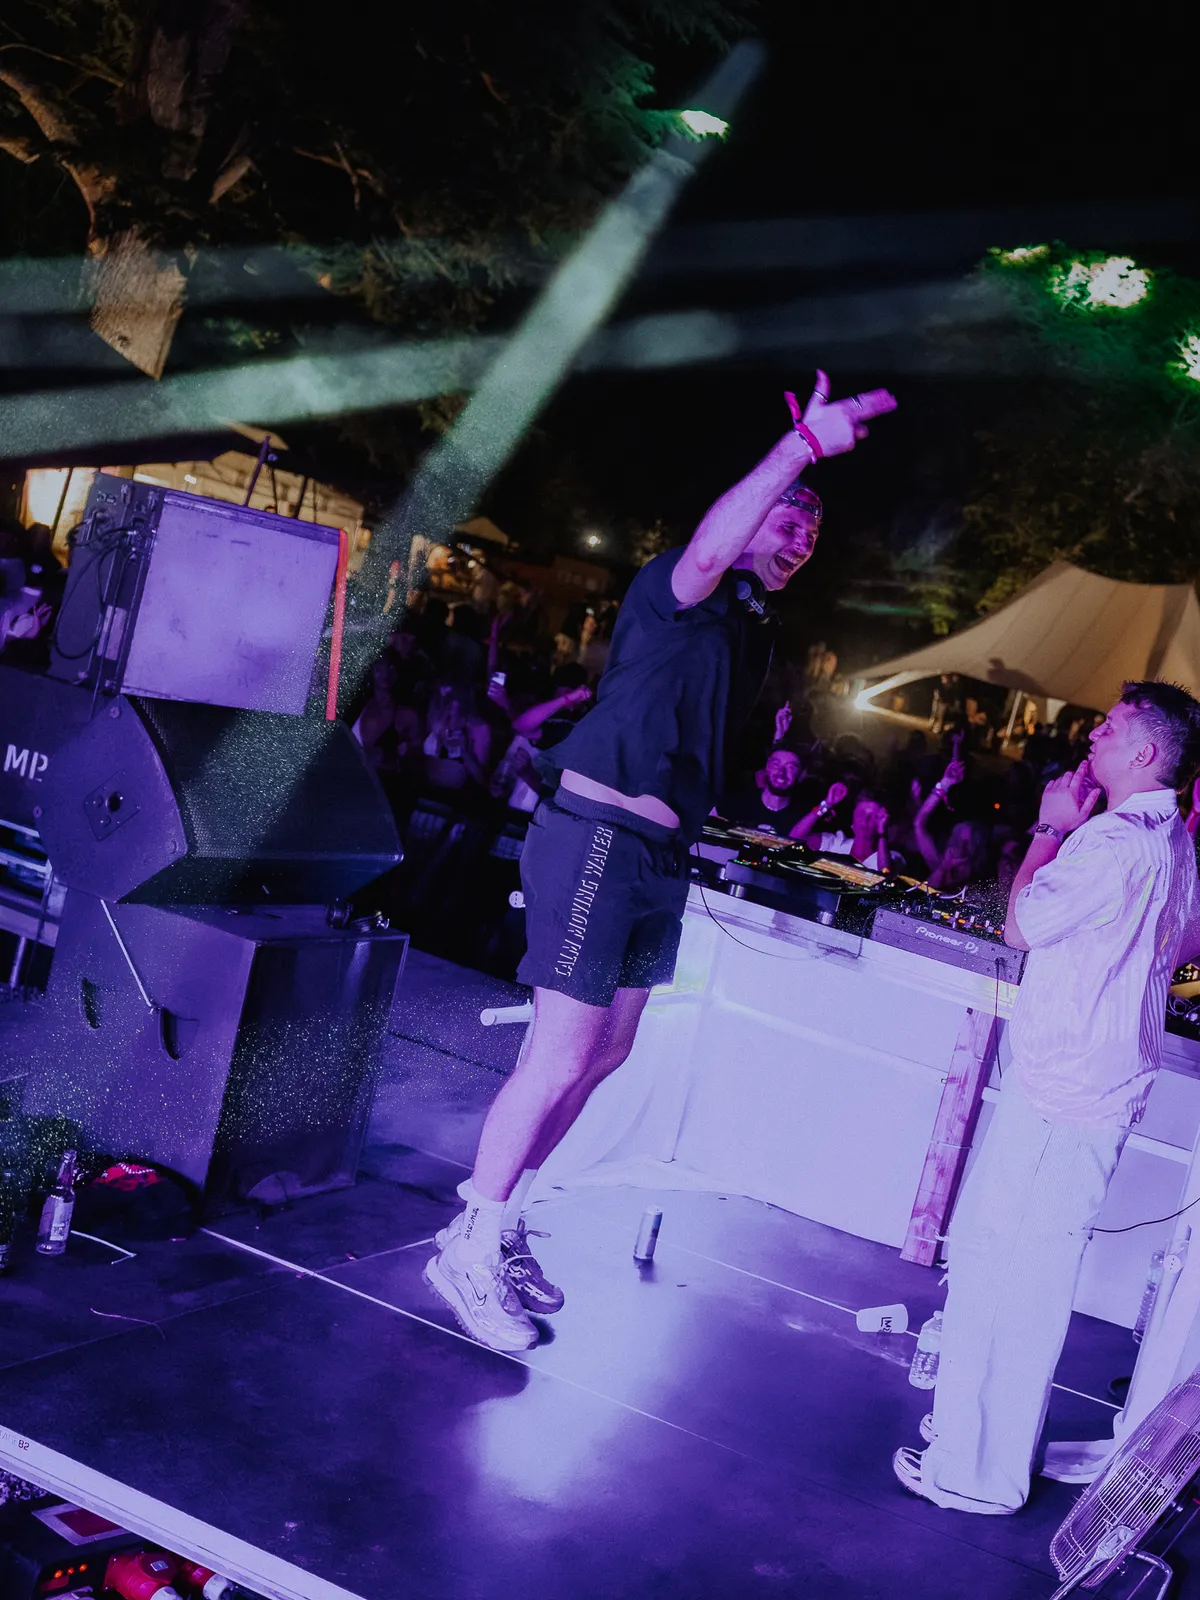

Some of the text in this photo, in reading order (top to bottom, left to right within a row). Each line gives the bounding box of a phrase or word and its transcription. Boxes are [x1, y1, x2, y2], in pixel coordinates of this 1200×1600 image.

[3, 743, 49, 783] MP
[554, 826, 614, 978] CALM MOVING WATER
[915, 926, 963, 947] Pioneer
[18, 1439, 30, 1451] 82
